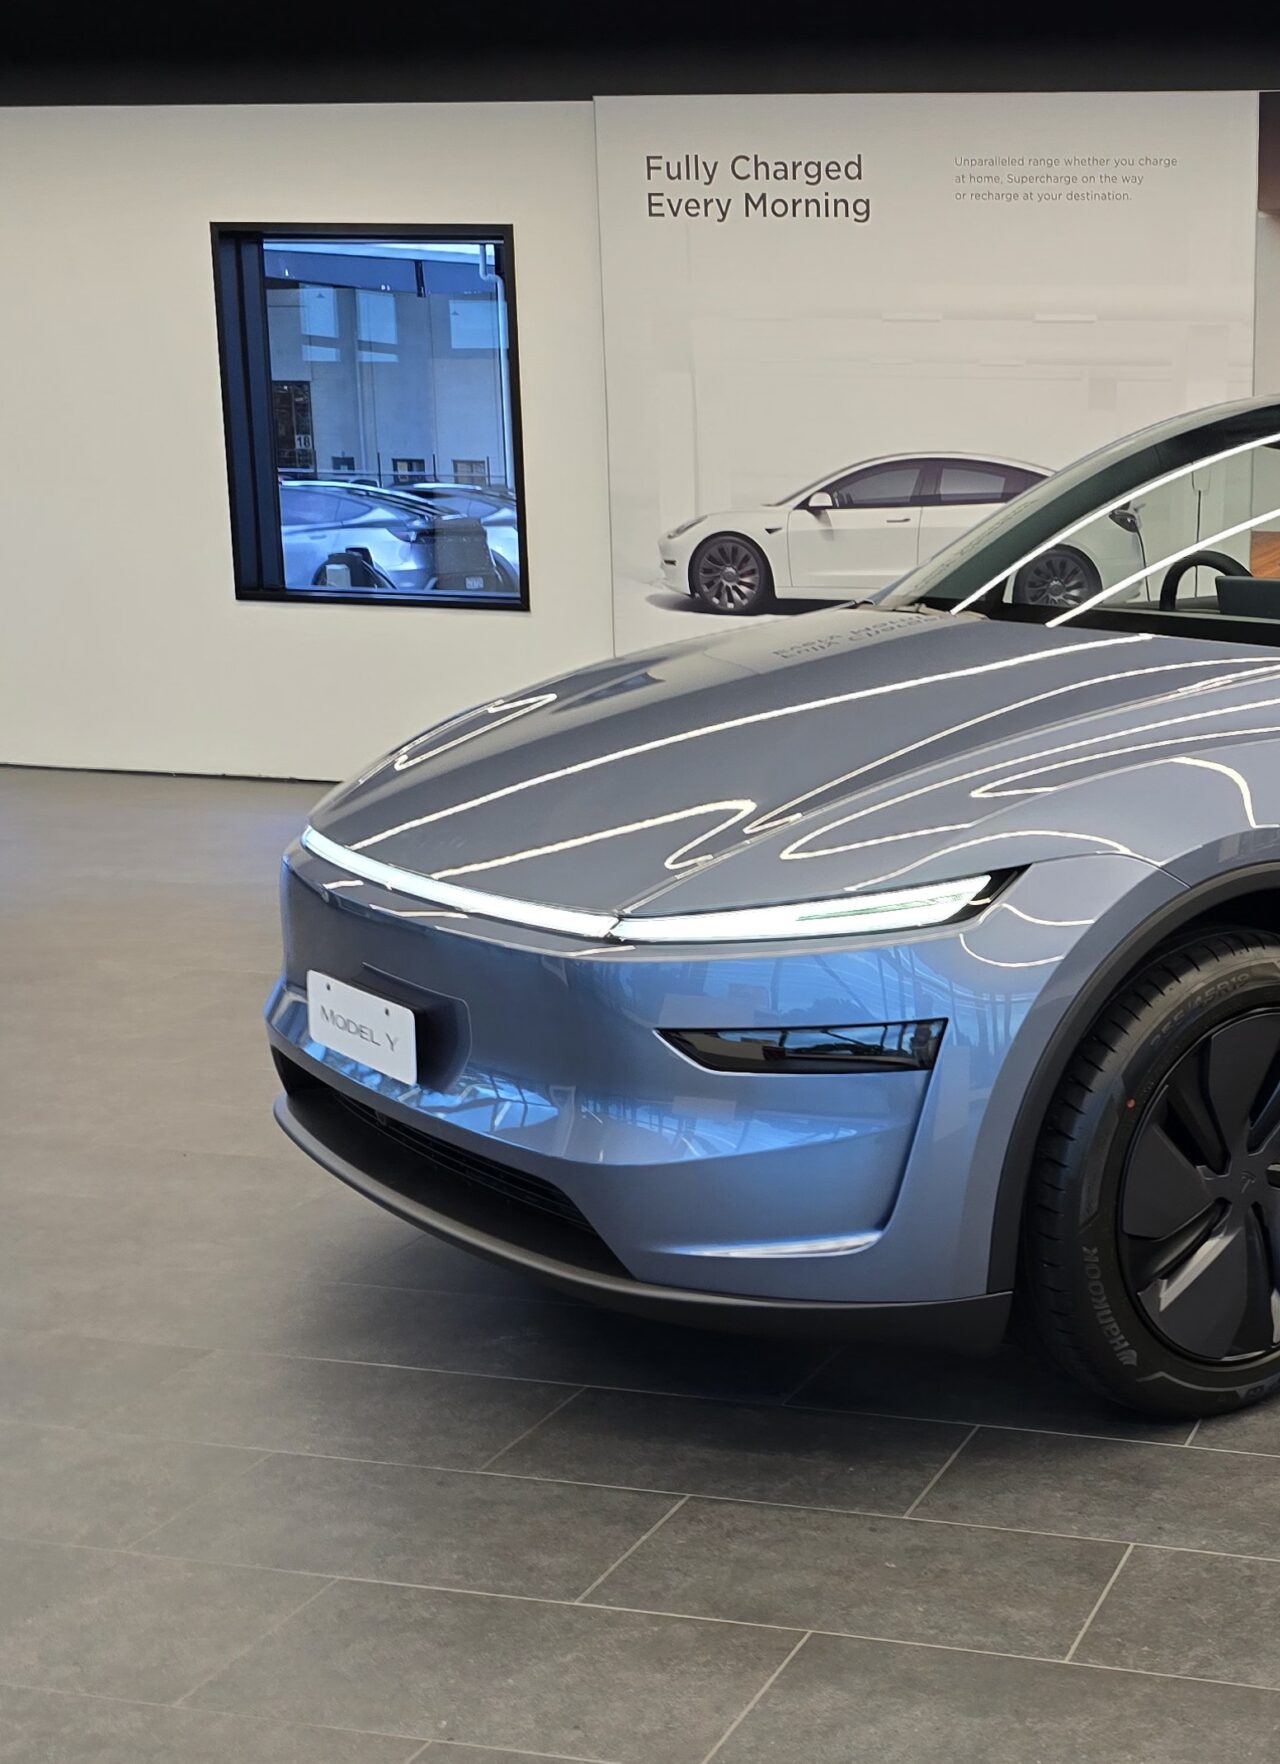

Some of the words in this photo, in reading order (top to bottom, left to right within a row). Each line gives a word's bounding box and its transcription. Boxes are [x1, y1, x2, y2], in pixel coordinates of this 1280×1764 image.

[955, 157, 1024, 168] Unparalleled
[1029, 158, 1060, 168] range
[1064, 156, 1110, 166] whether
[1114, 158, 1135, 168] you
[1139, 156, 1178, 168] charge
[646, 155, 718, 185] Fully
[731, 154, 863, 185] Charged
[955, 175, 965, 183] at
[1007, 173, 1078, 185] Supercharge
[1082, 175, 1095, 183] on
[1100, 174, 1117, 183] the
[1122, 176, 1144, 186] way
[955, 192, 966, 200] or
[970, 191, 1019, 202] recharge
[1023, 191, 1033, 200] at
[1037, 192, 1062, 202] your
[1066, 191, 1132, 201] destination.
[647, 192, 731, 223] Every
[745, 192, 871, 223] Morning
[297, 436, 311, 448] 18
[320, 1005, 381, 1047] MODEL
[385, 1032, 399, 1052] Y
